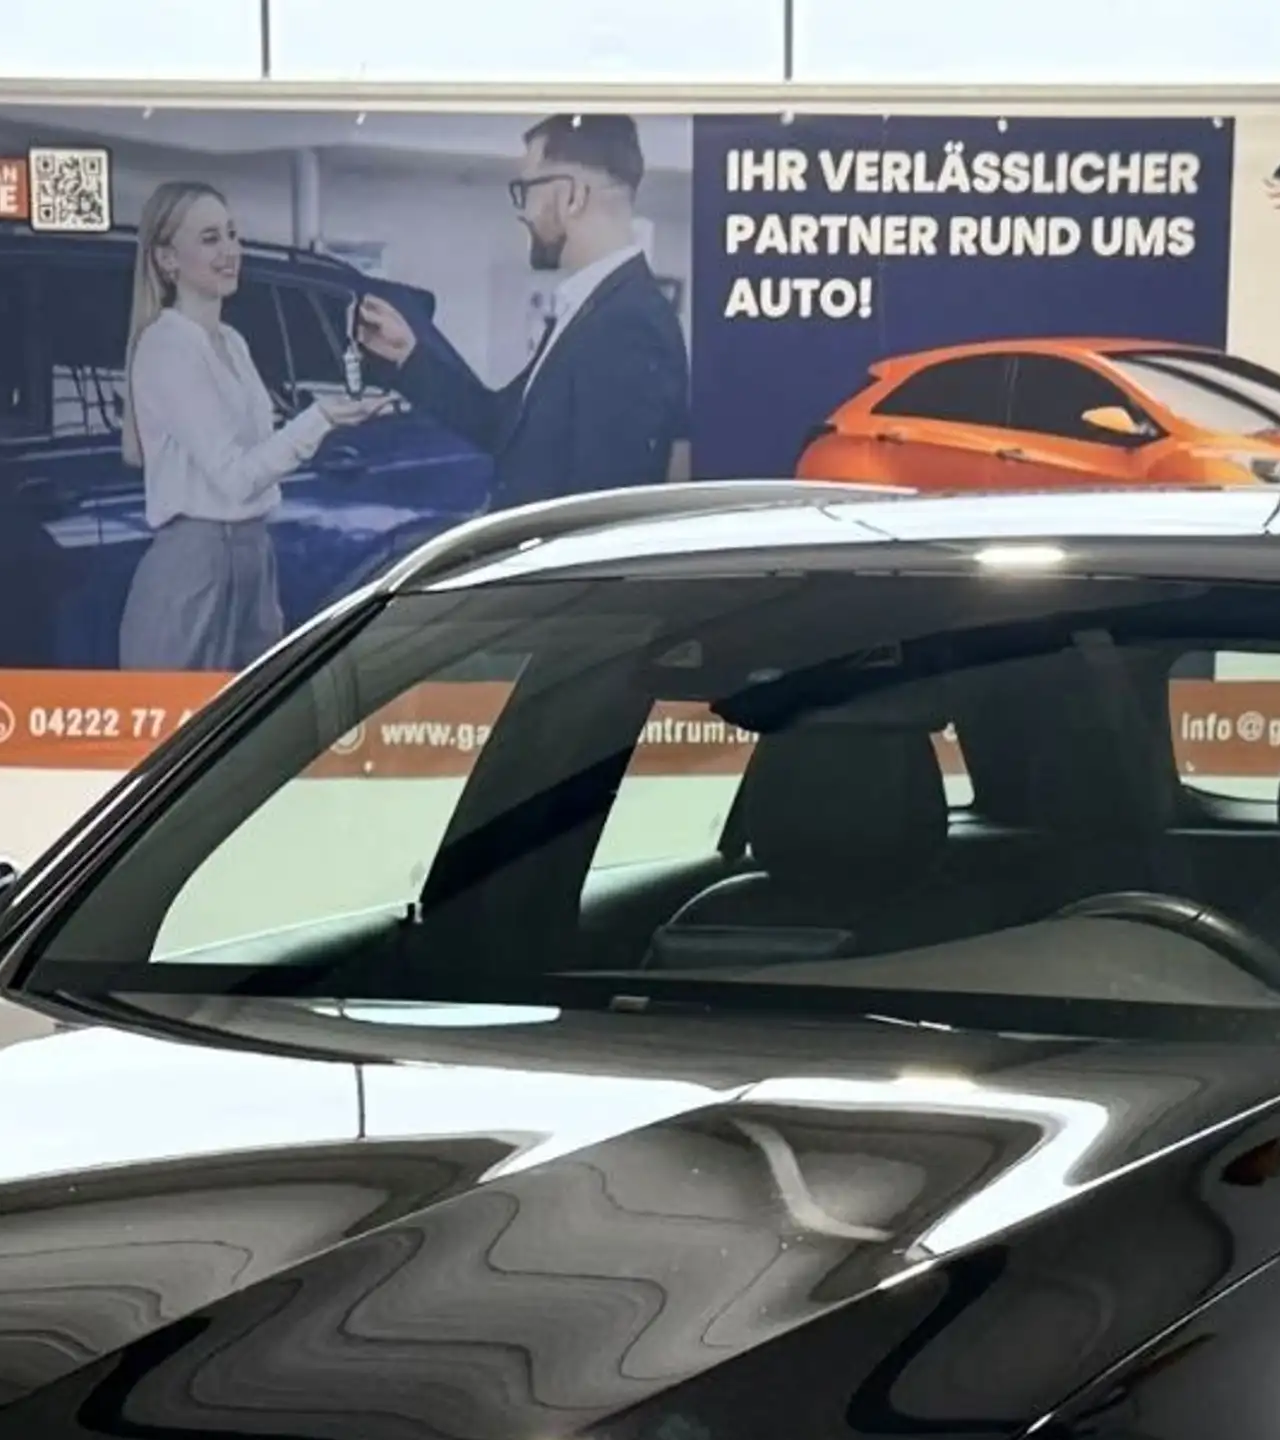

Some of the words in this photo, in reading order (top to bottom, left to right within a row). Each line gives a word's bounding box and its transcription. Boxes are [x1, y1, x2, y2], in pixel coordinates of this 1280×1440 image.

[726, 149, 808, 193] IHR
[820, 141, 1200, 195] VERLÄSSLICHER
[725, 213, 938, 256] PARTNER
[949, 215, 1081, 257] RUND
[1091, 215, 1196, 257] UMS
[724, 276, 872, 318] AUTO!
[29, 706, 119, 737] 04222
[131, 707, 167, 739] 77
